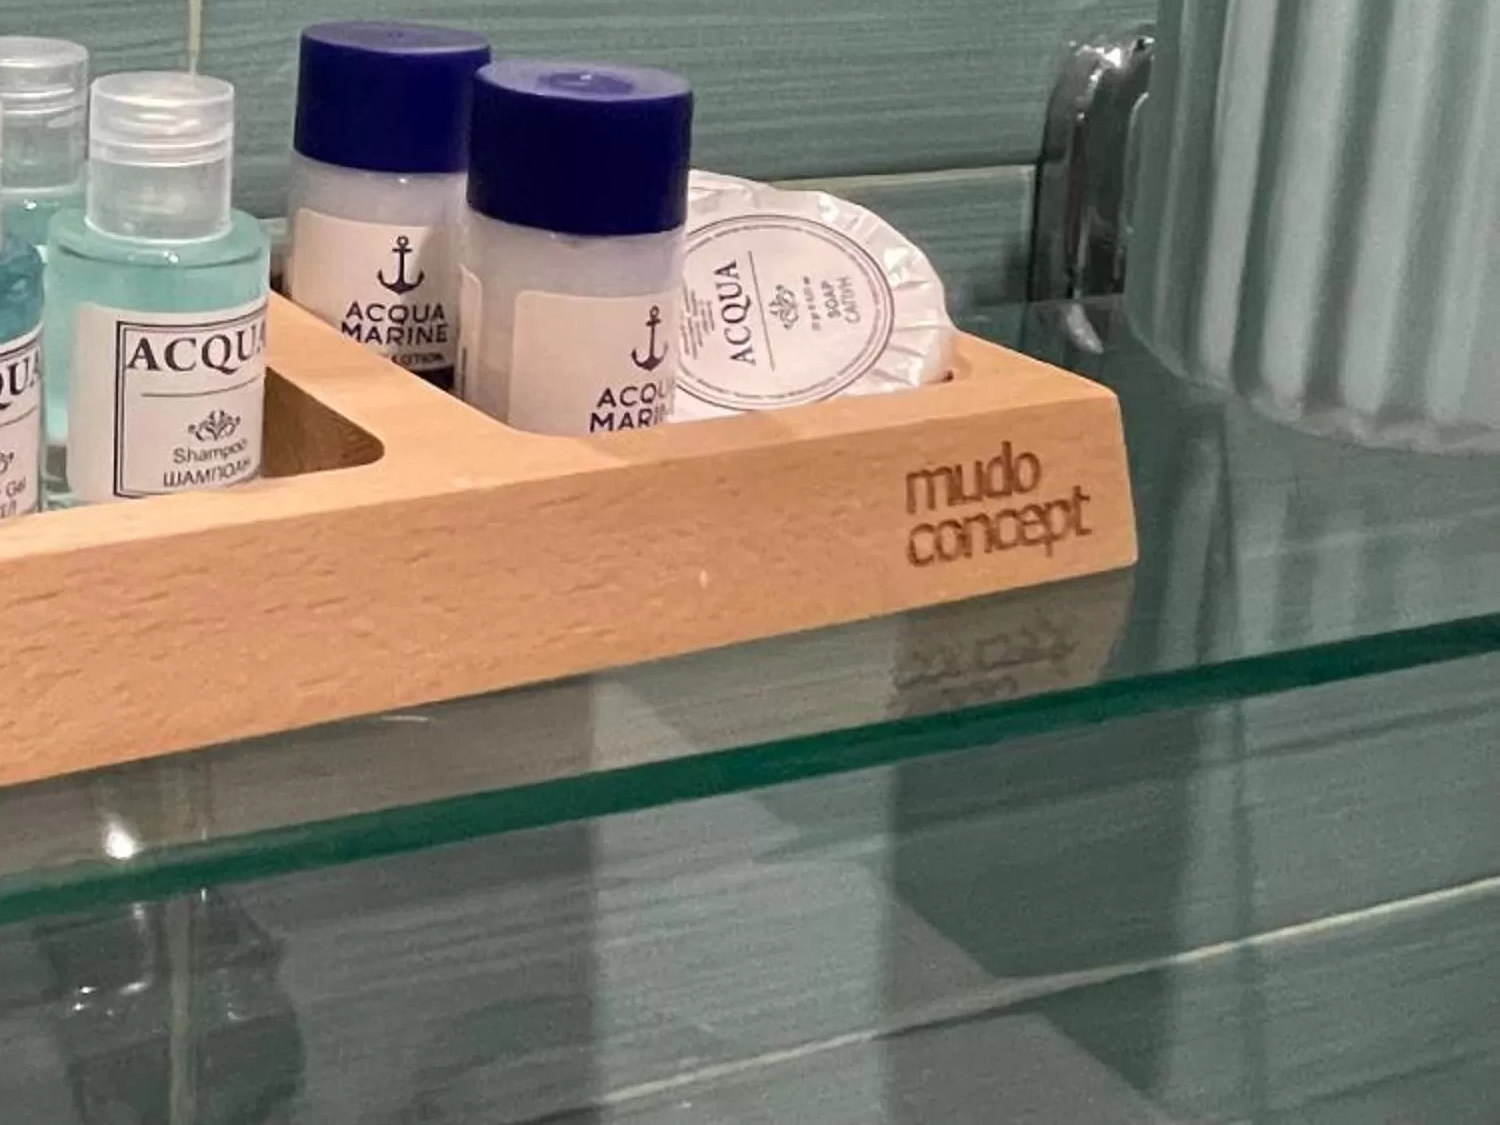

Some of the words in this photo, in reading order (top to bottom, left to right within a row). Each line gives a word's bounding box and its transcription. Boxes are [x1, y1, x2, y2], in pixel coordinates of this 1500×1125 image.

[345, 300, 445, 325] ACQUA
[713, 259, 757, 366] ACQUA
[821, 280, 841, 318] SOAP
[341, 321, 449, 346] MARINE
[173, 438, 248, 464] Shampoo
[905, 440, 1042, 514] mudo
[906, 485, 1093, 567] concept
